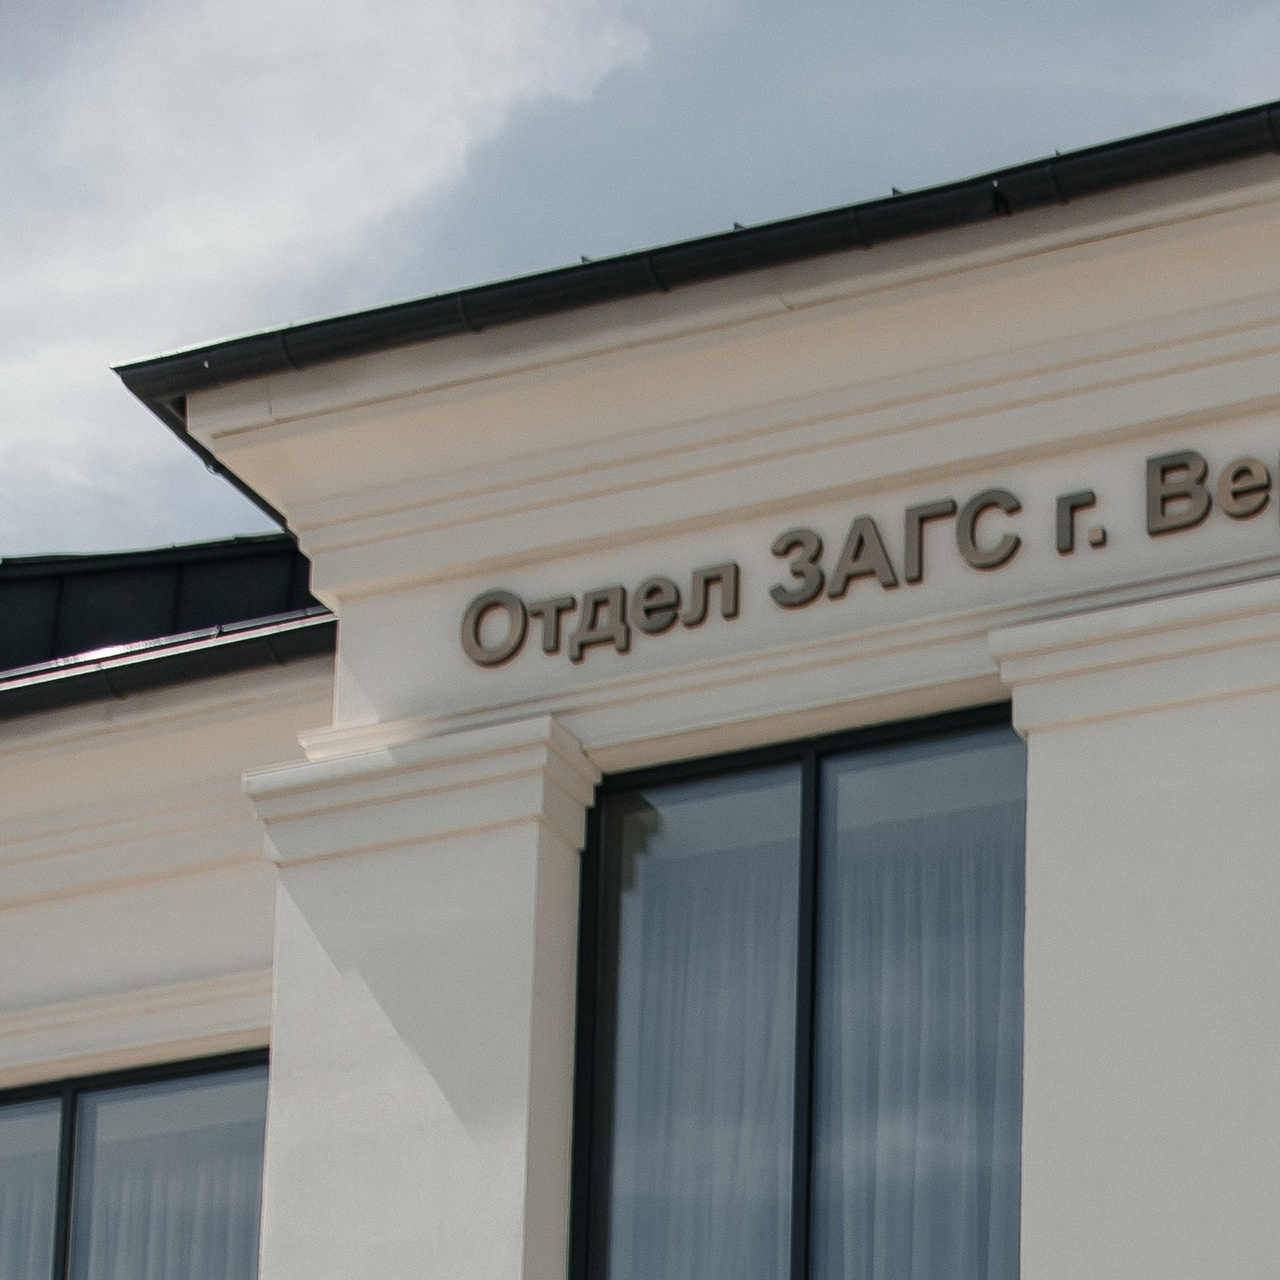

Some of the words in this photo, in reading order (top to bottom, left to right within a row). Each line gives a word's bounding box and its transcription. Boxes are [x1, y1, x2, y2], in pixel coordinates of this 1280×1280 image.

[460, 561, 740, 668] Отдел
[769, 488, 1022, 608] ЗАГС
[1054, 489, 1106, 554] г.
